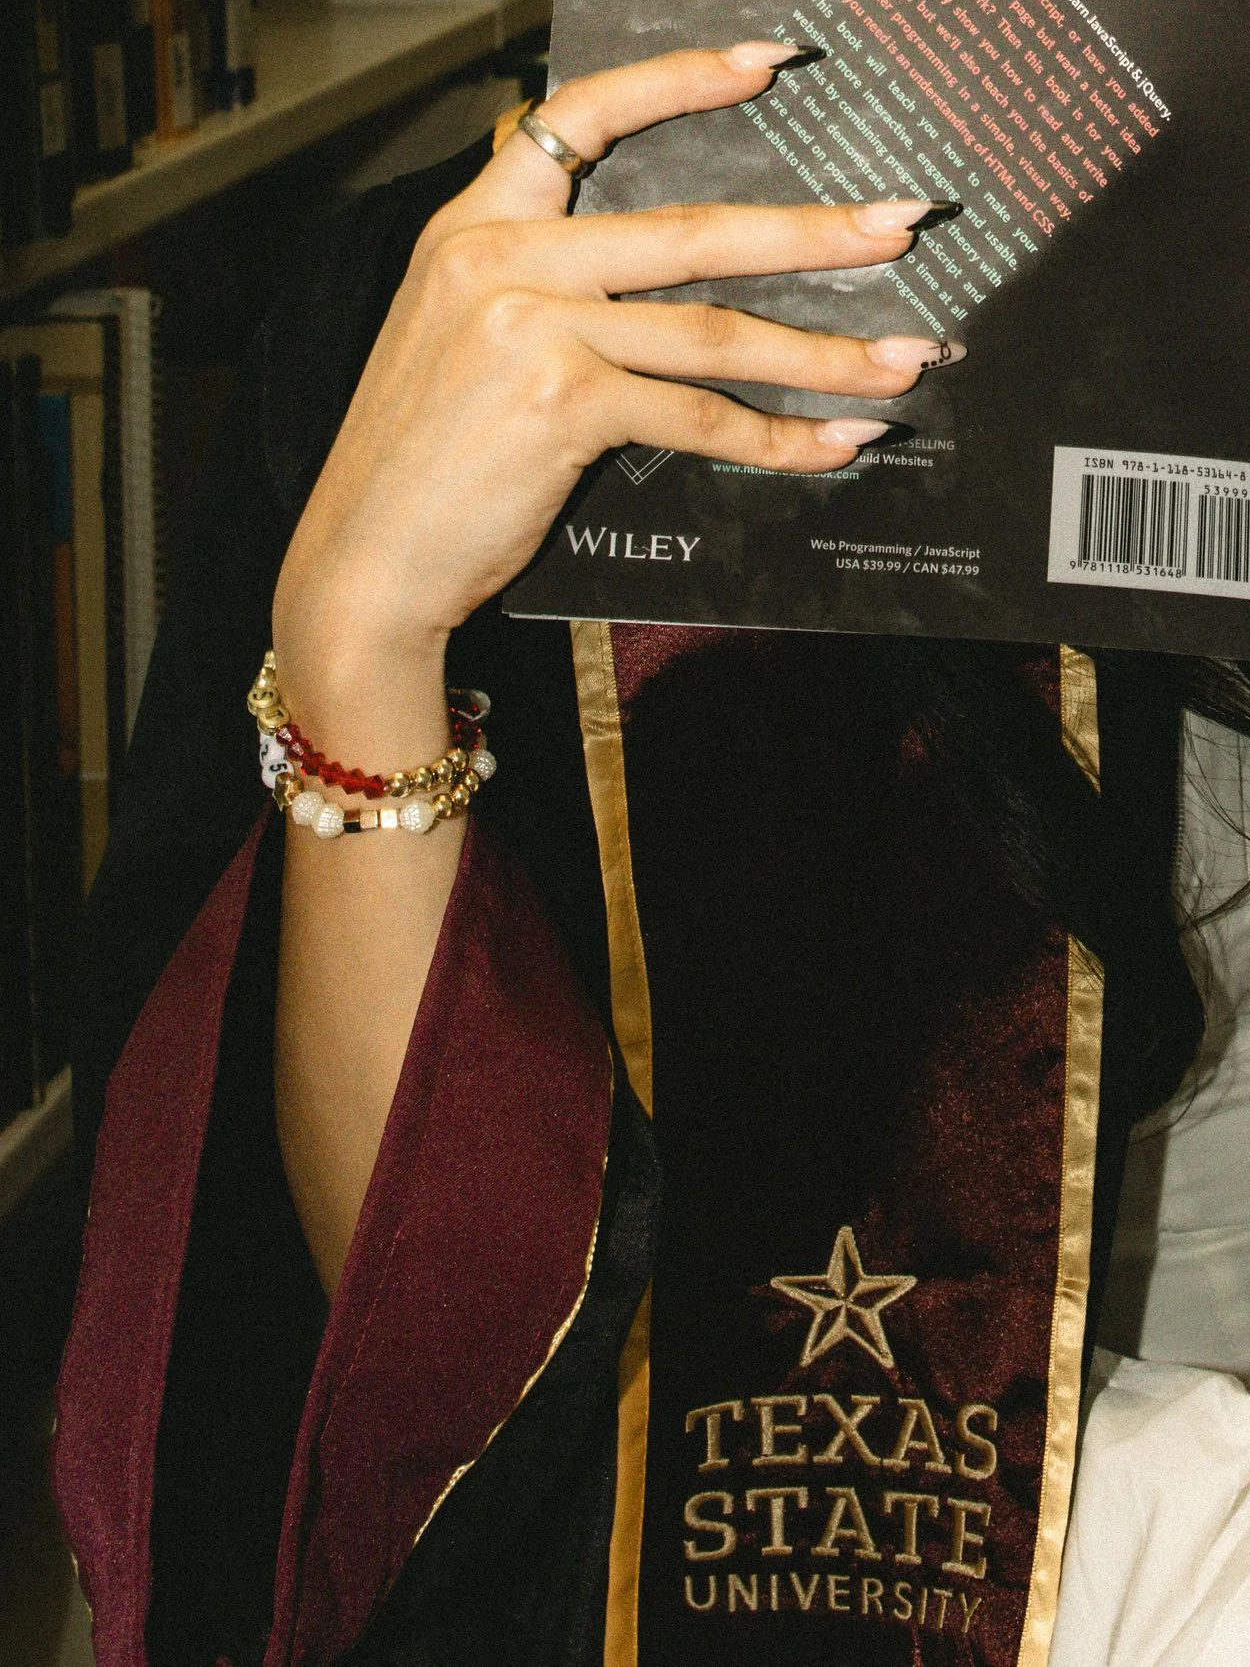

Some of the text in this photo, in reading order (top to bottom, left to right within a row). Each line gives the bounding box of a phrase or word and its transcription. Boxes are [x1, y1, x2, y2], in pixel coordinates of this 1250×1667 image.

[1086, 15, 1134, 72] JavaScript
[916, 0, 936, 23] but
[959, 51, 980, 75] also
[981, 75, 1008, 108] teach
[1007, 108, 1028, 131] you
[1029, 130, 1046, 152] the
[1046, 151, 1078, 189] basics
[1078, 190, 1094, 203] of
[952, 6, 980, 36] show
[978, 38, 1000, 60] you
[1000, 60, 1023, 86] how
[1023, 87, 1036, 102] to
[1037, 104, 1063, 131] read
[1061, 133, 1084, 155] and
[1082, 157, 1108, 188] write
[997, 17, 1022, 49] Then
[1024, 50, 1044, 74] this
[1045, 74, 1070, 106] book
[1072, 106, 1083, 121] is
[1085, 122, 1101, 141] for
[1100, 145, 1122, 171] you.
[1008, 0, 1035, 28] page
[1036, 27, 1055, 50] but
[1055, 51, 1081, 80] want
[1079, 81, 1089, 91] a
[1089, 90, 1120, 126] better
[1119, 126, 1141, 154] idea
[1068, 30, 1081, 43] or
[1082, 44, 1106, 74] have
[1105, 77, 1126, 99] you
[1127, 102, 1160, 138] added
[1131, 68, 1142, 82] &
[1136, 77, 1171, 121] jQuery.
[857, 454, 934, 467] uild Websites
[1084, 457, 1246, 482] ISBN 978-1-118-53164-8
[1204, 485, 1248, 498] 53999
[565, 525, 701, 562] WILEY
[811, 539, 836, 551] Web
[839, 541, 912, 557] Programming
[923, 545, 981, 560] JavaScript
[836, 558, 860, 570] USA
[863, 559, 902, 572] $39.99
[913, 563, 939, 574] CAN
[941, 564, 980, 576] $47.99
[685, 1394, 998, 1480] TEXAS
[684, 1486, 992, 1580] STATE
[684, 1572, 982, 1634] UNIVERSITY
